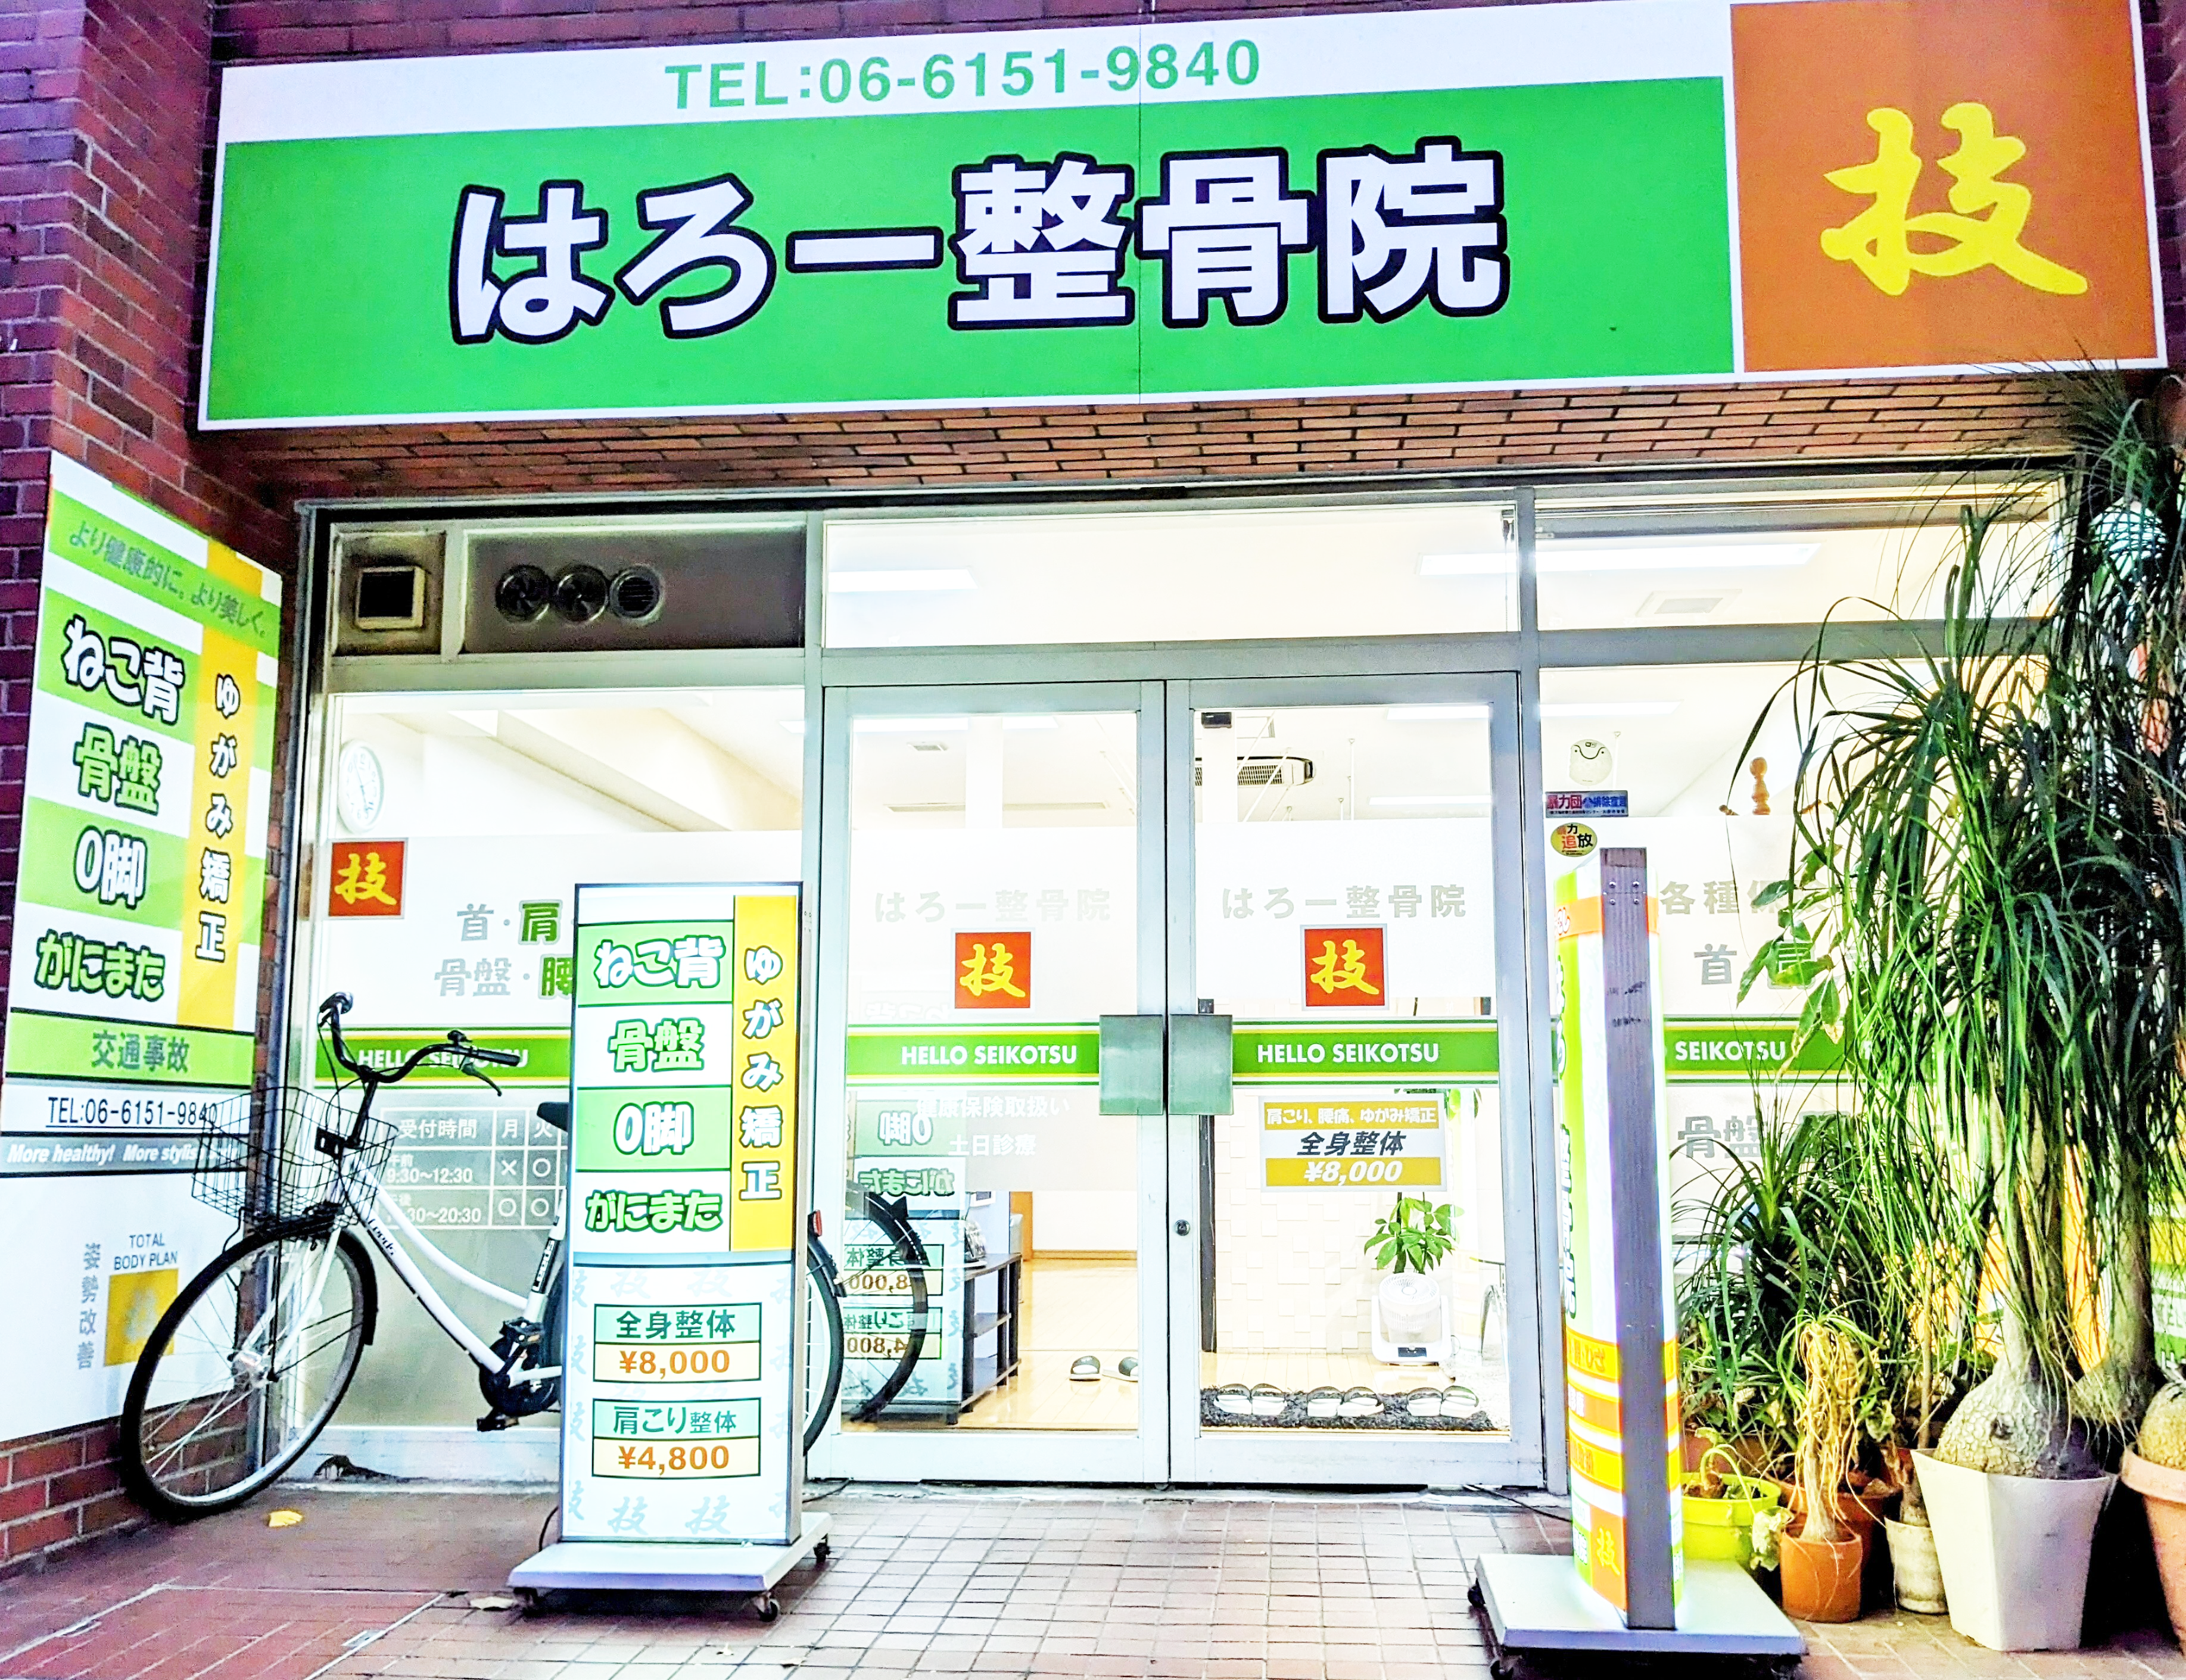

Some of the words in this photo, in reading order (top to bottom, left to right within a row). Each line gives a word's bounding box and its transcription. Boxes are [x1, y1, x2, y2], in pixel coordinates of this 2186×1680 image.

[665, 39, 1260, 110] TEL:06-6151-9840
[1821, 102, 2088, 297] 技
[450, 136, 1510, 345] はろー整骨院
[60, 613, 185, 725] ねこ背
[72, 721, 163, 816] 骨盤
[195, 673, 242, 963] ゆがみ矯正
[334, 852, 397, 905] 技
[874, 888, 1111, 922] はろー整骨院
[1222, 884, 1466, 919] はろー整骨院
[35, 928, 166, 1002] がにまた
[594, 934, 725, 989] ねこ背
[959, 943, 1026, 998] 技
[1310, 940, 1380, 995] 技
[91, 1030, 191, 1073] 交通事故
[608, 1018, 706, 1072] 骨盤
[901, 1046, 968, 1065] HELLO
[974, 1045, 1078, 1064] SEIKOTSU
[1257, 1044, 1325, 1063] HELLO
[1332, 1043, 1439, 1062] SEIKOTSU
[1674, 1041, 1786, 1061] SEIKOTSU
[740, 946, 784, 1201] ゆがみ矯正
[916, 1095, 1071, 1118] 健康保険取扱い
[400, 1119, 477, 1139] 受付時間
[948, 1133, 1036, 1157] 土日診療
[1297, 1131, 1407, 1156] 全身整体
[7, 1143, 49, 1163] More
[52, 1144, 116, 1165] healthy!
[123, 1144, 160, 1161] More
[1304, 1161, 1403, 1186] ¥8,000
[585, 1190, 724, 1233] がにまた
[129, 1233, 165, 1249] TOTAL
[114, 1254, 147, 1270] BODY
[149, 1251, 178, 1267] PLAN
[615, 1309, 736, 1339] 全身整体
[619, 1349, 730, 1380] ¥8,000
[613, 1406, 737, 1435] 肩こり整体
[618, 1445, 730, 1476] ¥4,800
